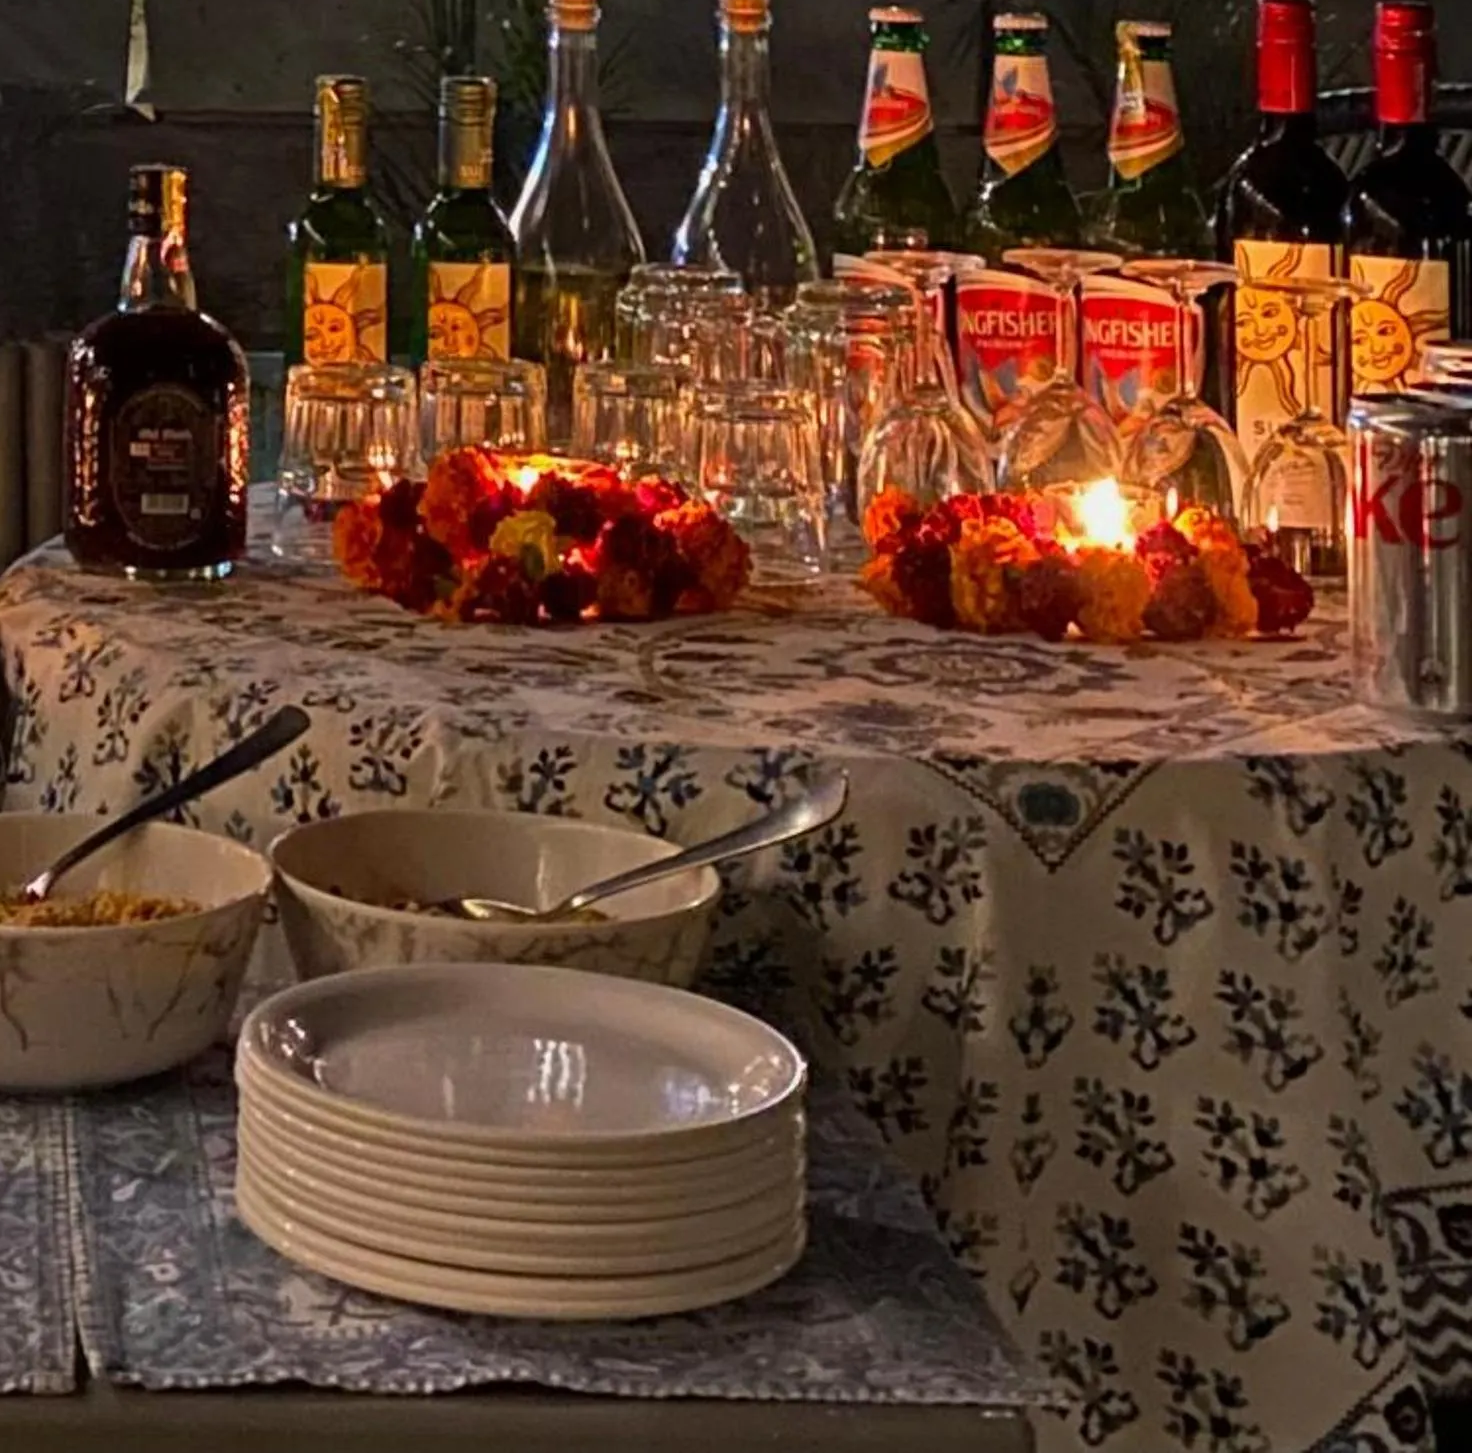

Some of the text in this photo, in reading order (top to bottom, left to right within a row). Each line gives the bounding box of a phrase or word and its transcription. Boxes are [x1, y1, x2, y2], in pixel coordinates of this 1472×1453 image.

[961, 310, 1056, 336] NGFISHER
[1084, 319, 1175, 348] NGFISHE
[1353, 442, 1463, 551] ke
